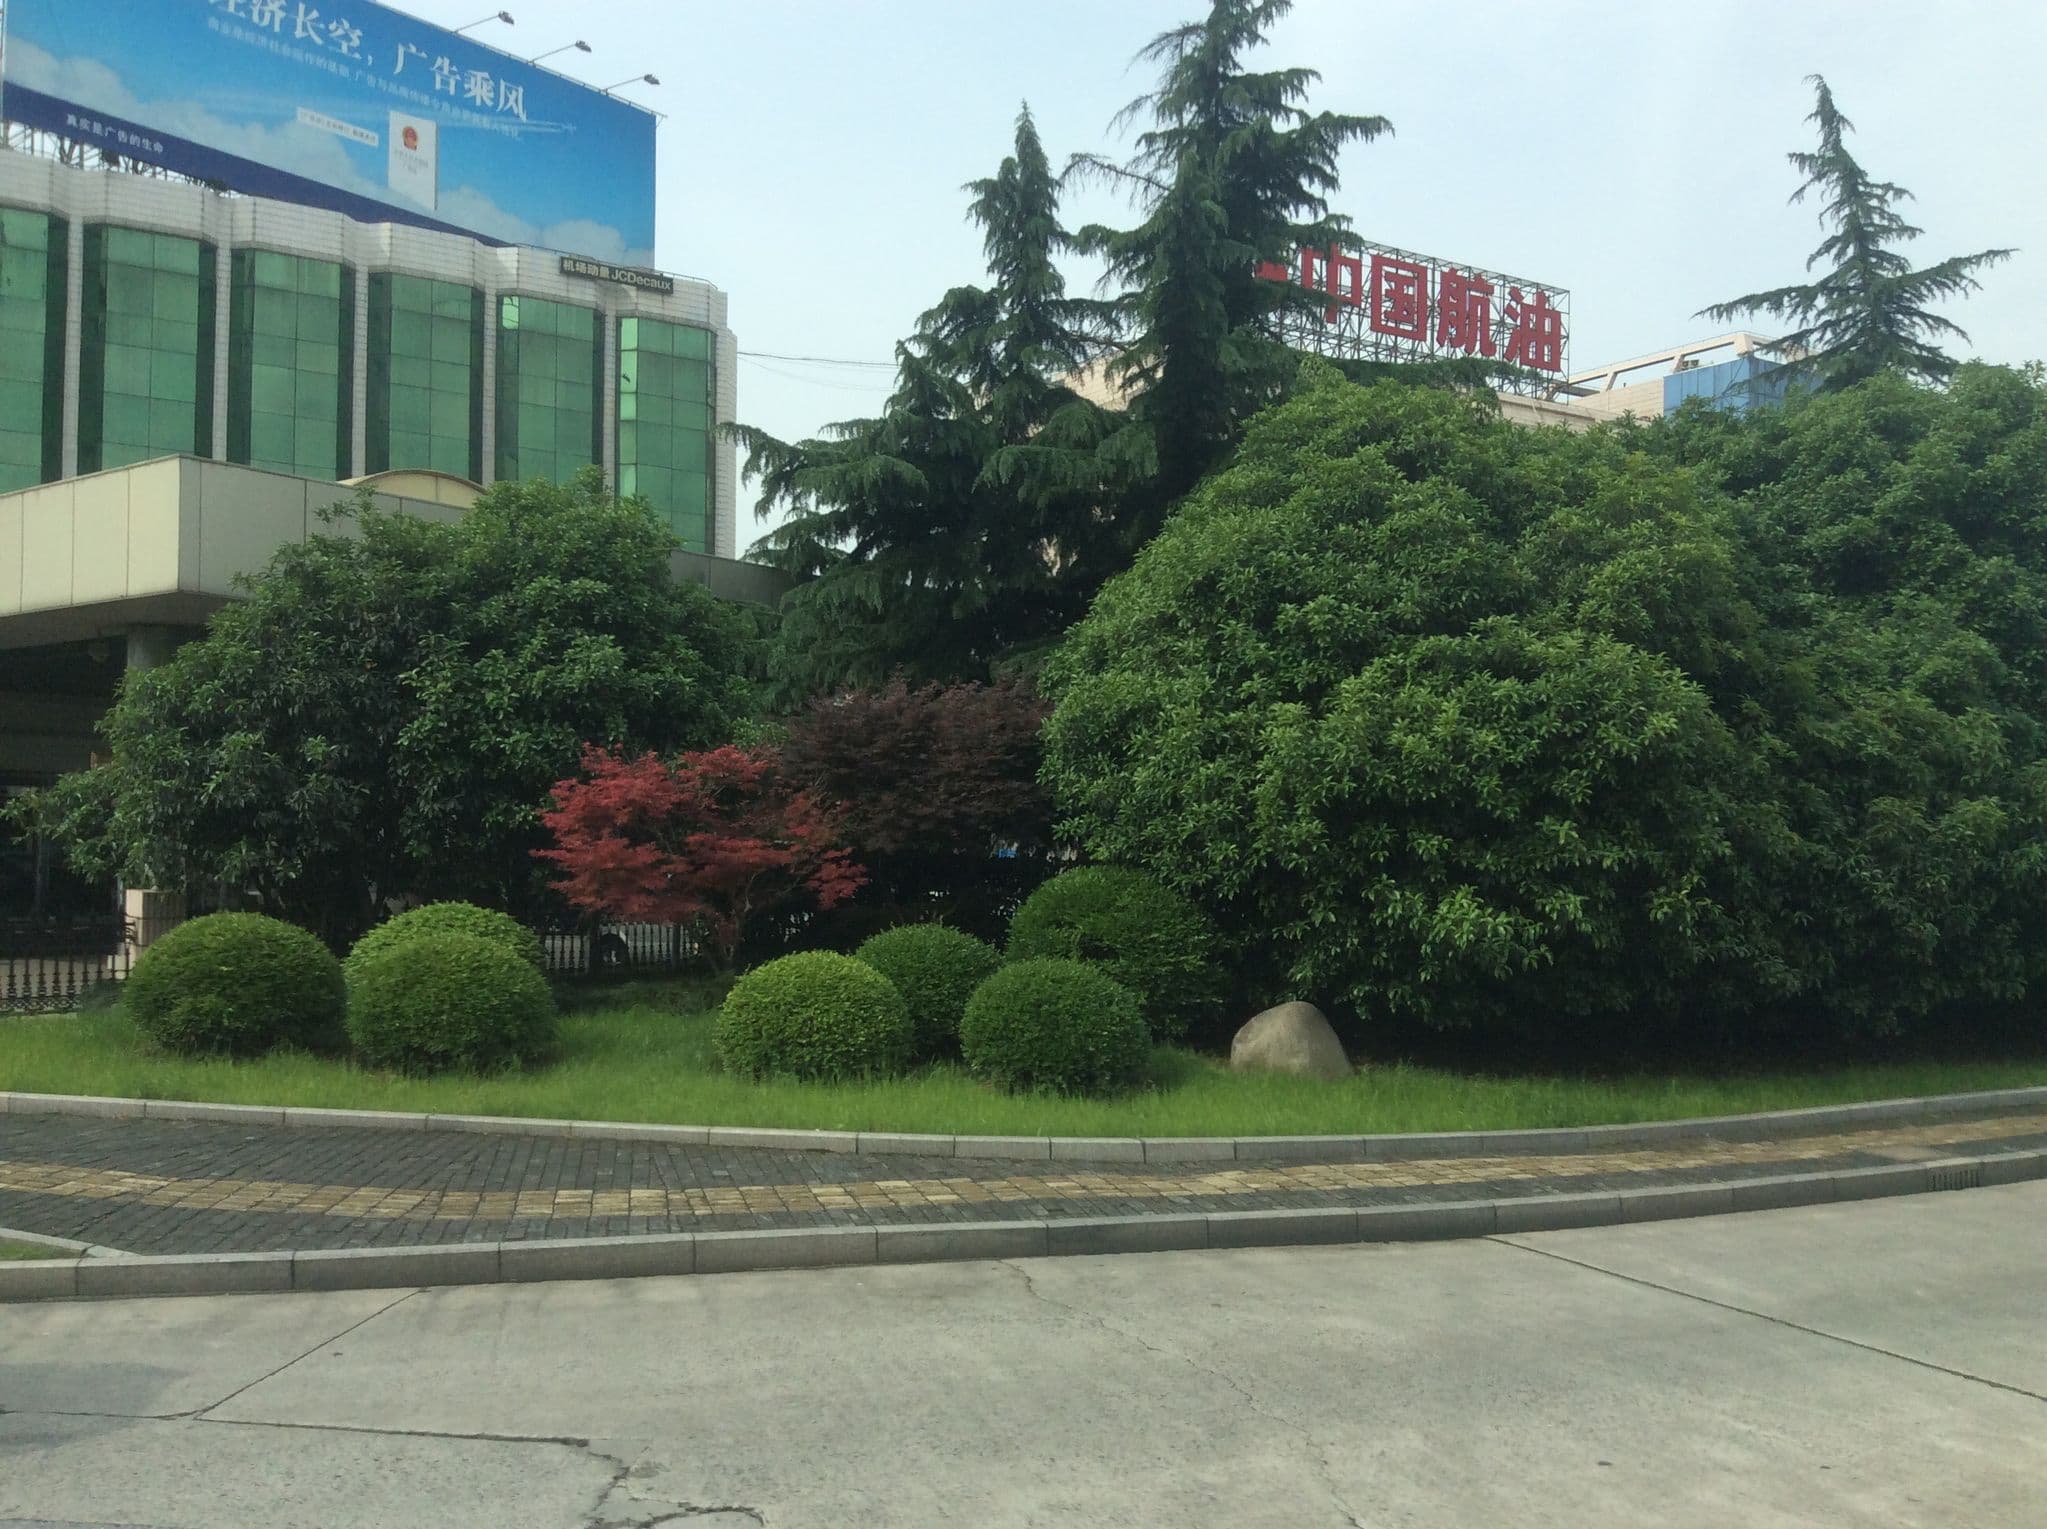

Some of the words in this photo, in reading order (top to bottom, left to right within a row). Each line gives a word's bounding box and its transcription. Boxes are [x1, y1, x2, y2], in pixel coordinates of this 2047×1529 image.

[611, 268, 672, 291] JCDecaux
[1301, 243, 1563, 372] 中国航油
